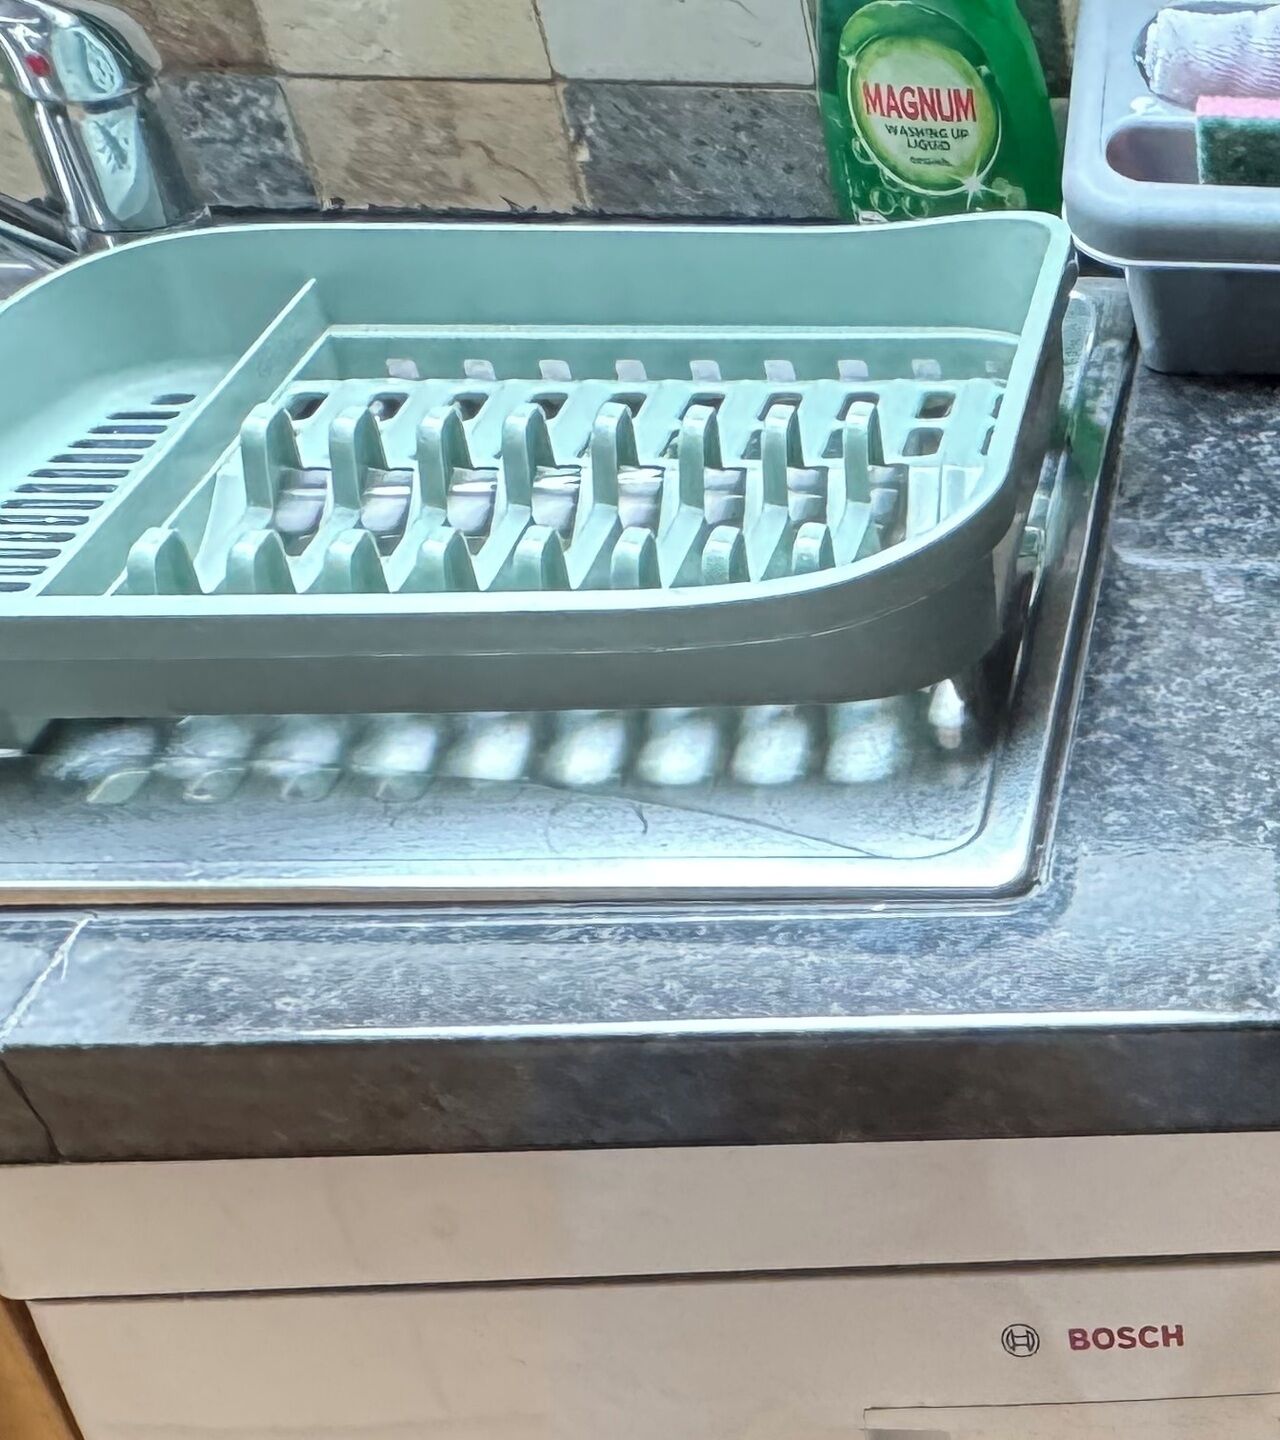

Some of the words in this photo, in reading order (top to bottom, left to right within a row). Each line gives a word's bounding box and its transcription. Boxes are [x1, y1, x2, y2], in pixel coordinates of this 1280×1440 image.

[862, 80, 977, 123] MAGNUM
[884, 123, 949, 139] WASHING
[951, 128, 970, 140] UP
[906, 138, 951, 151] LIQUID
[1068, 1324, 1185, 1351] BOSCH
